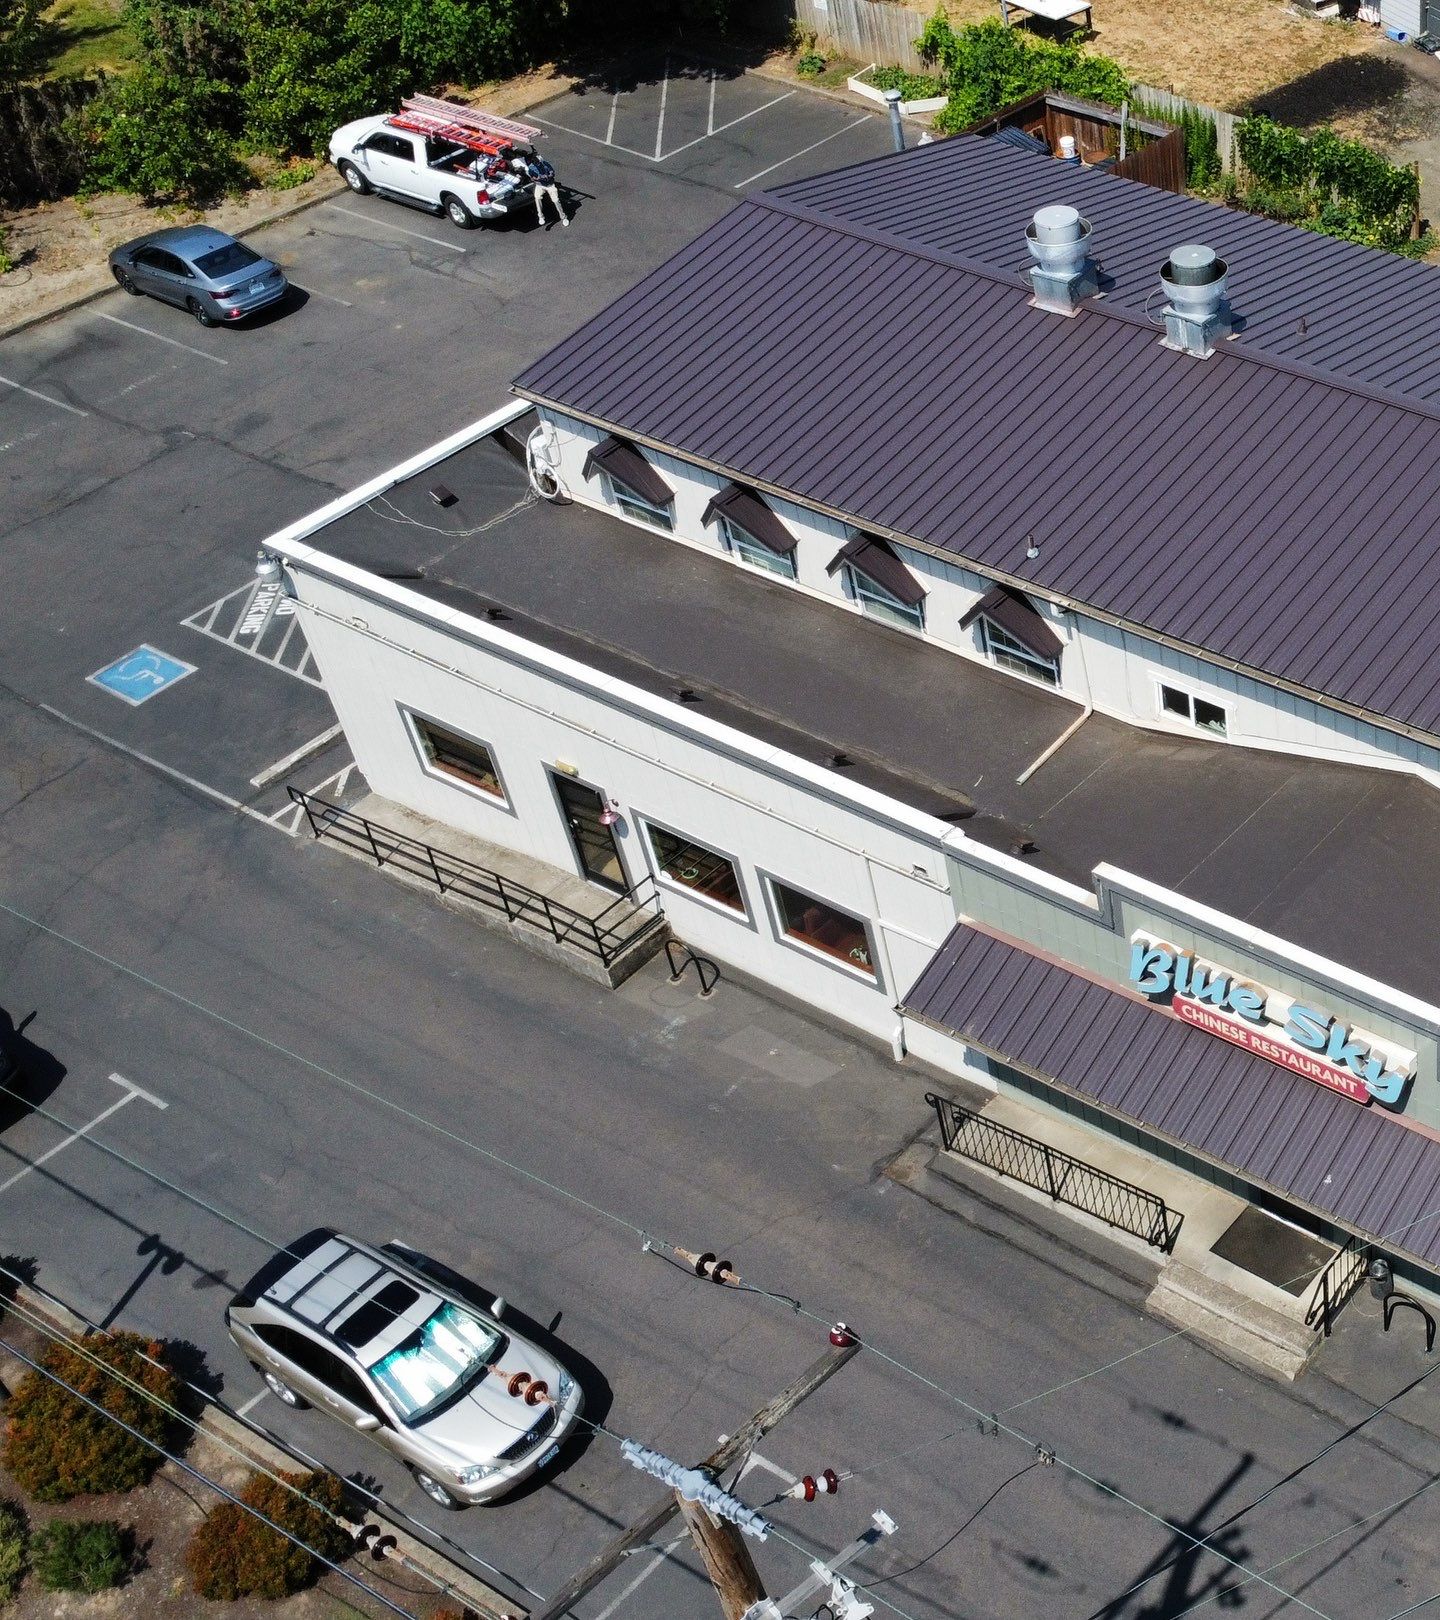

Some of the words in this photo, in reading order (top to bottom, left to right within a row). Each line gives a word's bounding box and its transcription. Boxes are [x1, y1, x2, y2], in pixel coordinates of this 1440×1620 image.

[239, 583, 281, 634] PARKING
[1129, 940, 1267, 1020] Blue
[1284, 1000, 1407, 1104] Sky
[1181, 1004, 1247, 1045] CHINESE
[1250, 1035, 1358, 1094] RESTAURANT
